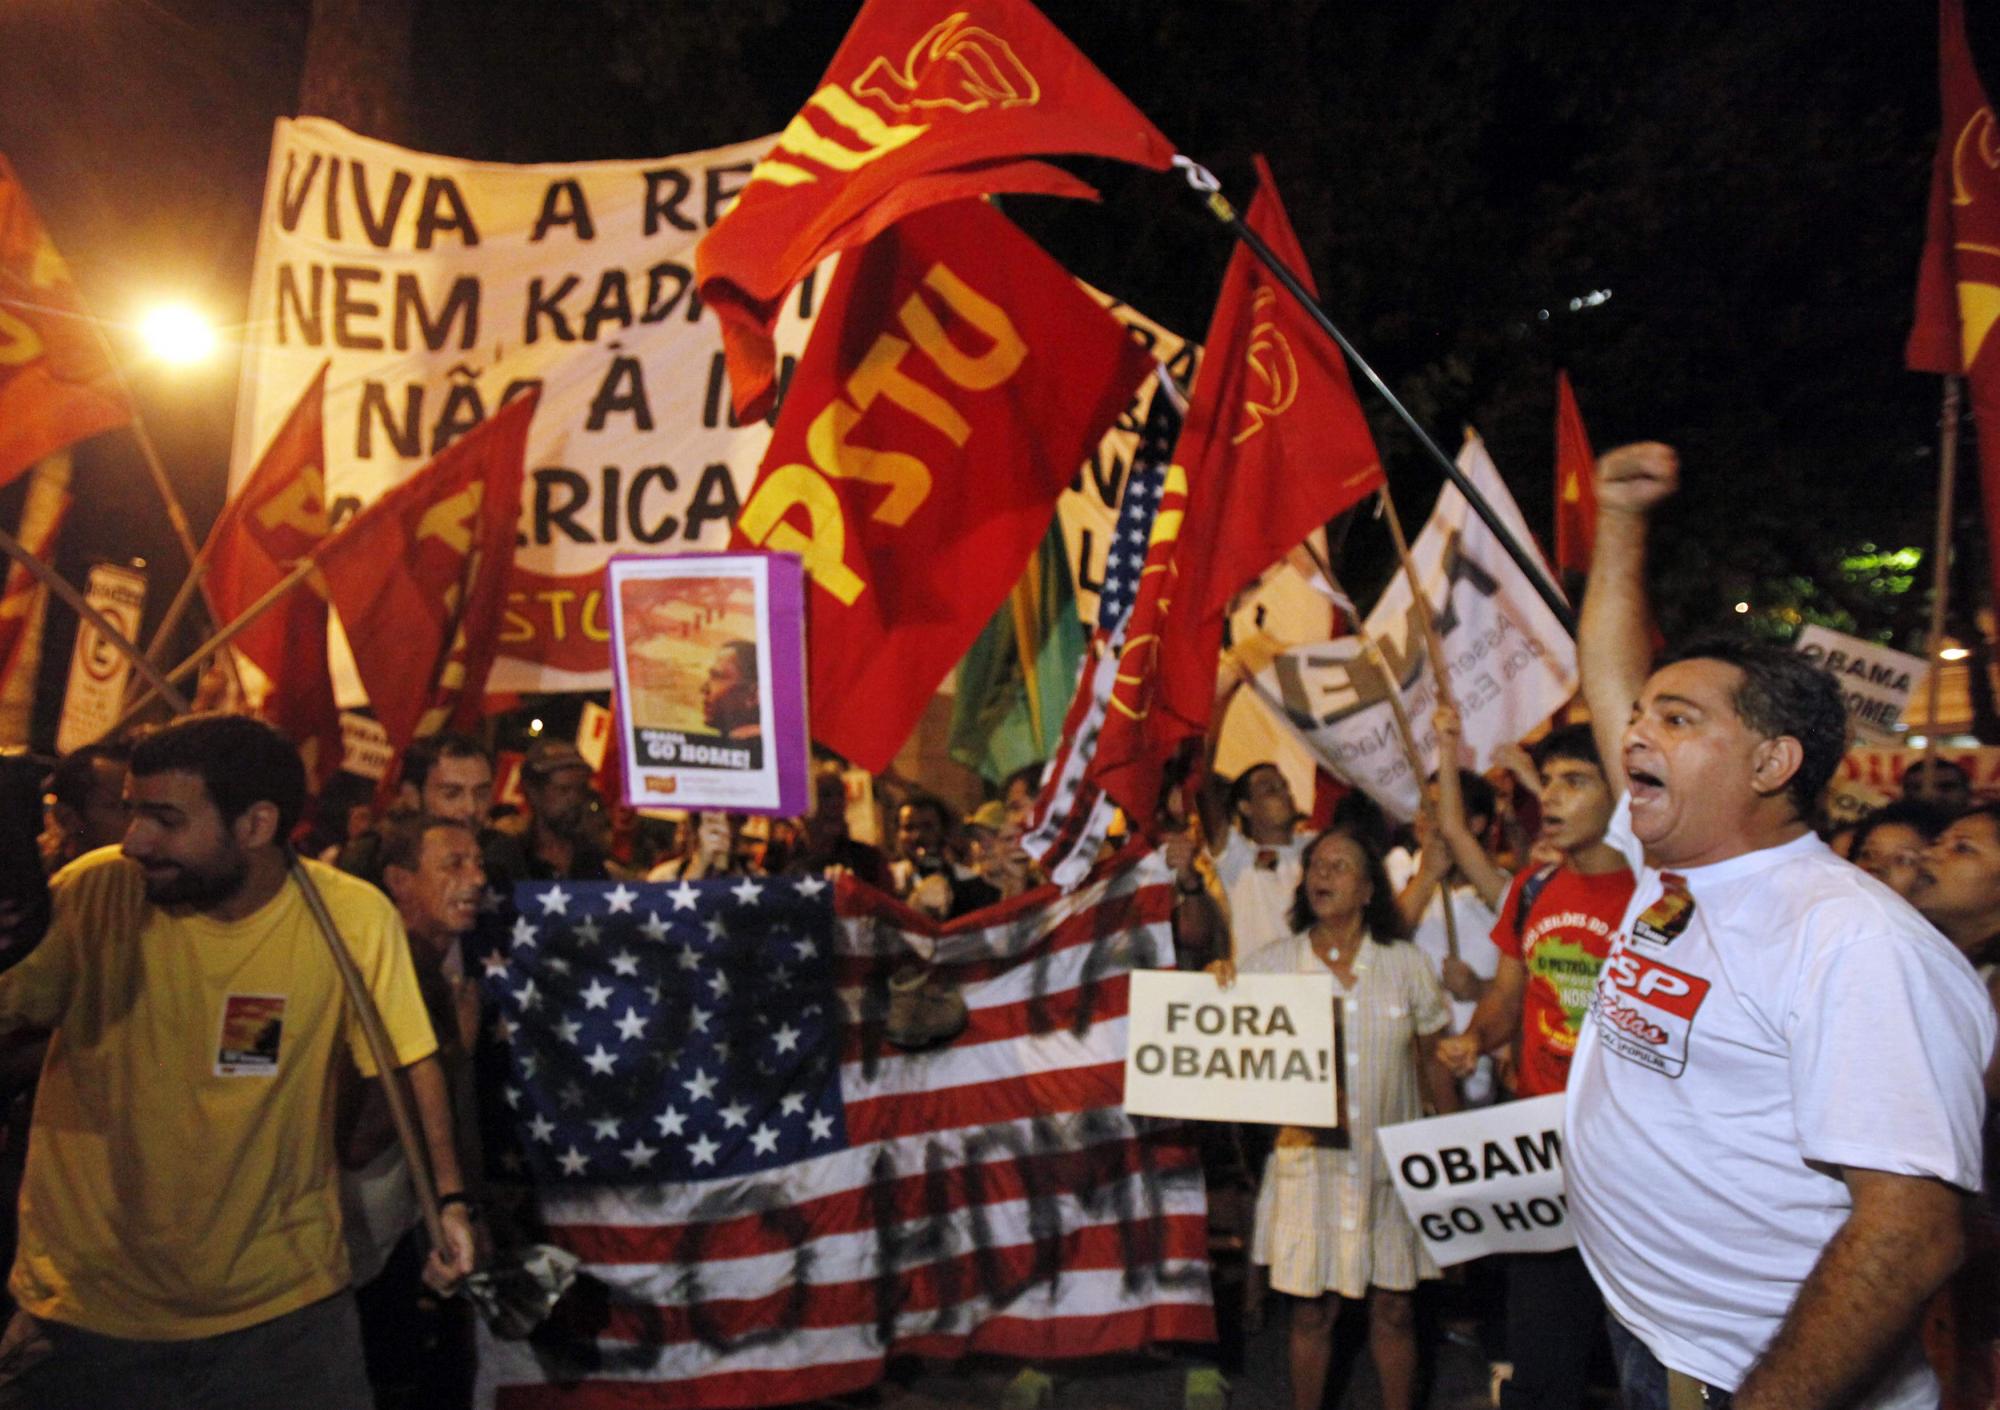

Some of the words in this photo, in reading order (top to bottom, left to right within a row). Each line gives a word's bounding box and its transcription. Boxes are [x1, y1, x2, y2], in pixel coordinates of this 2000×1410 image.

[281, 150, 480, 250] VIVA
[529, 176, 595, 241] A
[642, 162, 752, 236] RE
[278, 263, 481, 352] NEM
[738, 262, 1029, 607] PSTU
[1803, 643, 1911, 694] OBAMA
[647, 740, 677, 761] GO
[680, 743, 751, 770] HOME!
[1606, 953, 1691, 998] SP
[1166, 1001, 1296, 1037] FORA
[1134, 1043, 1329, 1083] OBAMA!
[1400, 1129, 1563, 1190] OBAM
[1420, 1206, 1485, 1242] GO
[1491, 1194, 1570, 1232] HO
